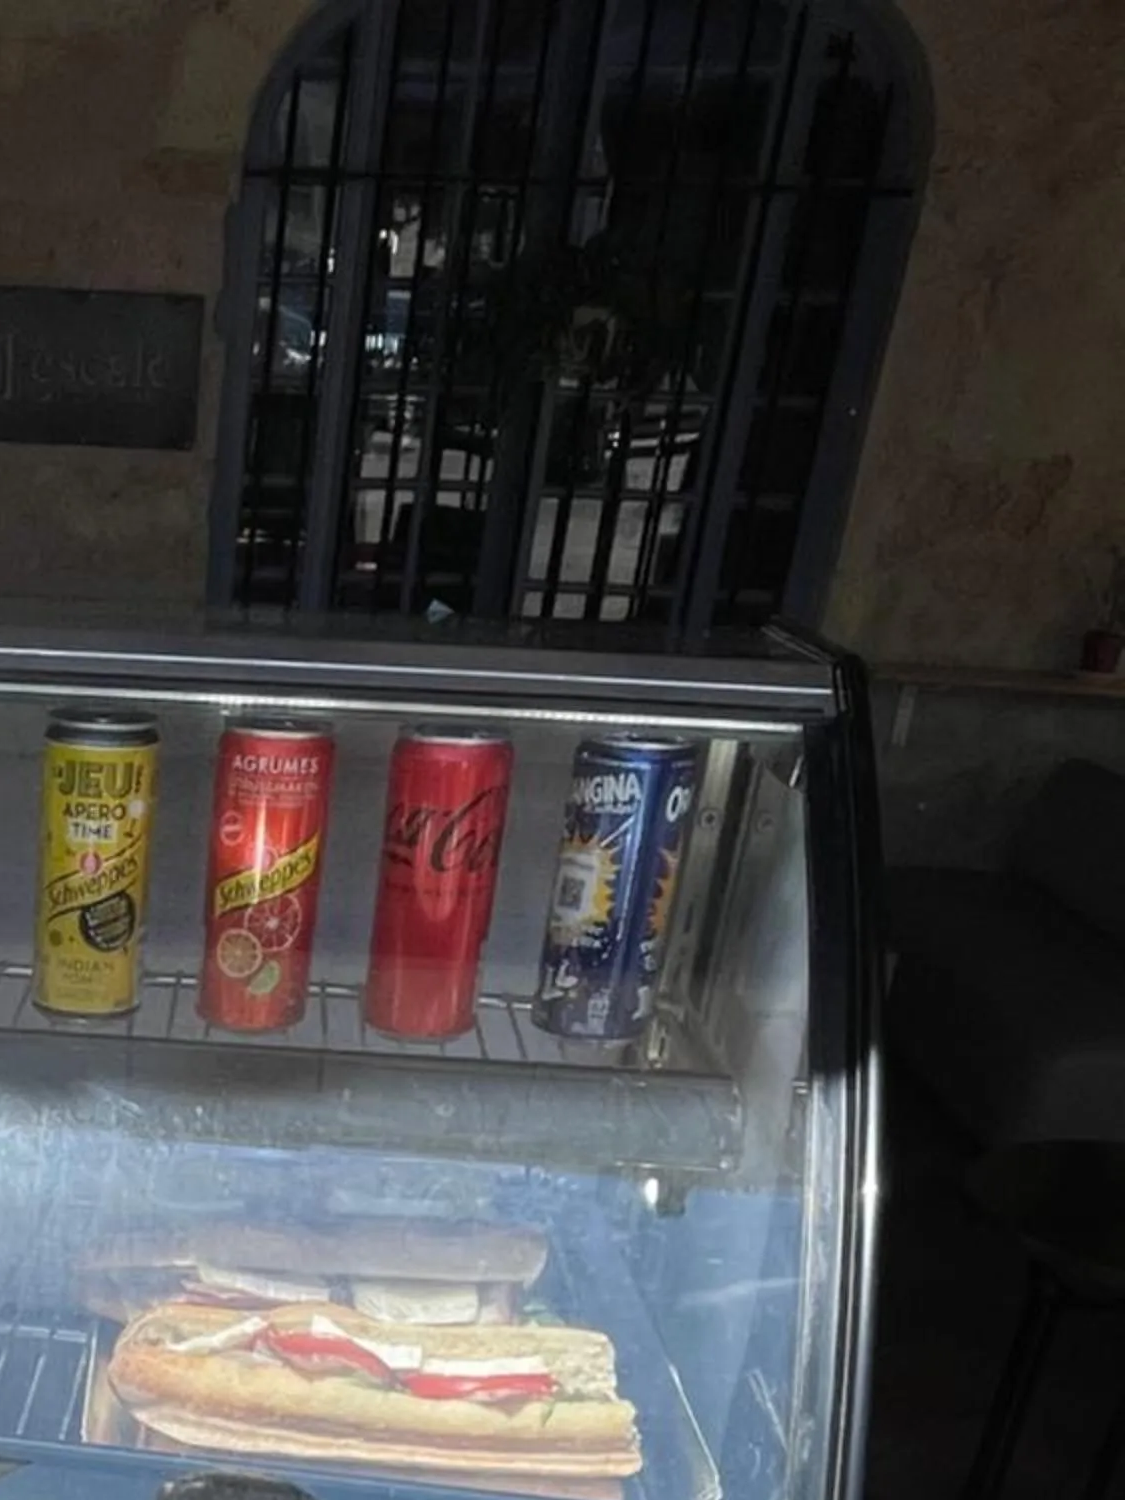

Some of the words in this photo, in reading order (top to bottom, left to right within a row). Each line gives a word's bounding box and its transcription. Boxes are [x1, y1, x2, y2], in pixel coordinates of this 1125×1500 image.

[232, 753, 320, 775] AGRUMES
[72, 822, 112, 839] TIME
[49, 855, 139, 910] Schweppes
